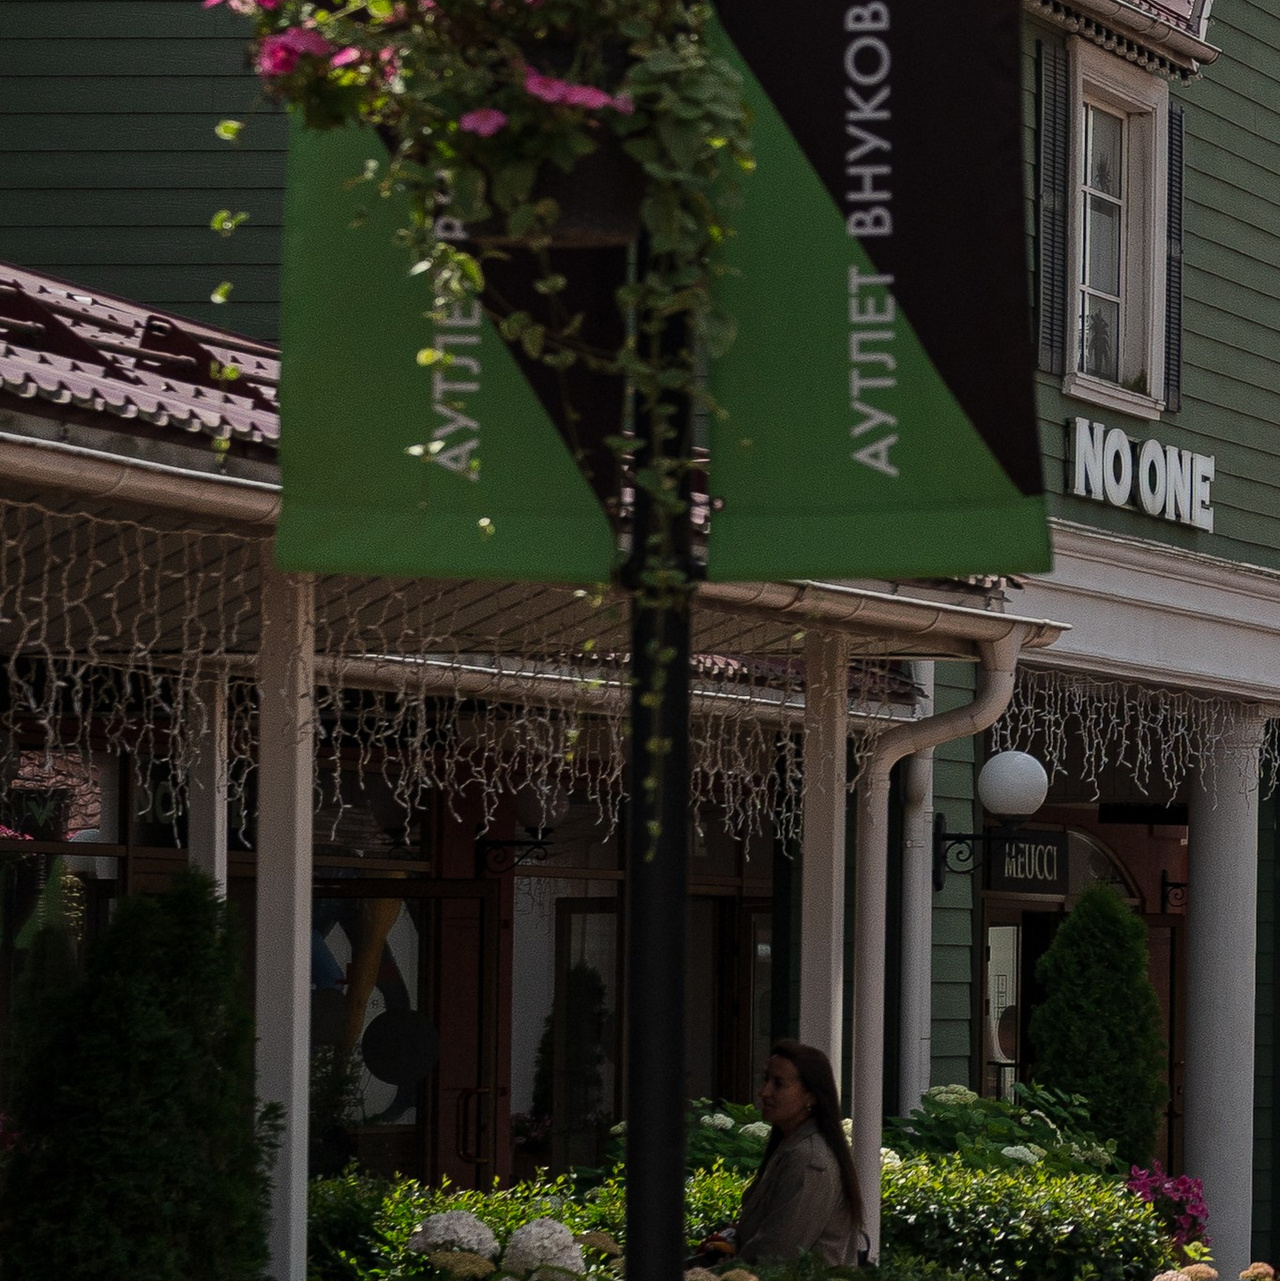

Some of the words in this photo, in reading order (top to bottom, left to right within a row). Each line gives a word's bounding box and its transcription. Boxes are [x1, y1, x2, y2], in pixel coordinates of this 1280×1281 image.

[431, 265, 483, 482] АУТЛЕ
[848, 265, 900, 478] АУТЛЕТ
[1074, 417, 1132, 507] NO
[1139, 438, 1215, 533] ONE
[1003, 842, 1058, 881] MEUCCI
